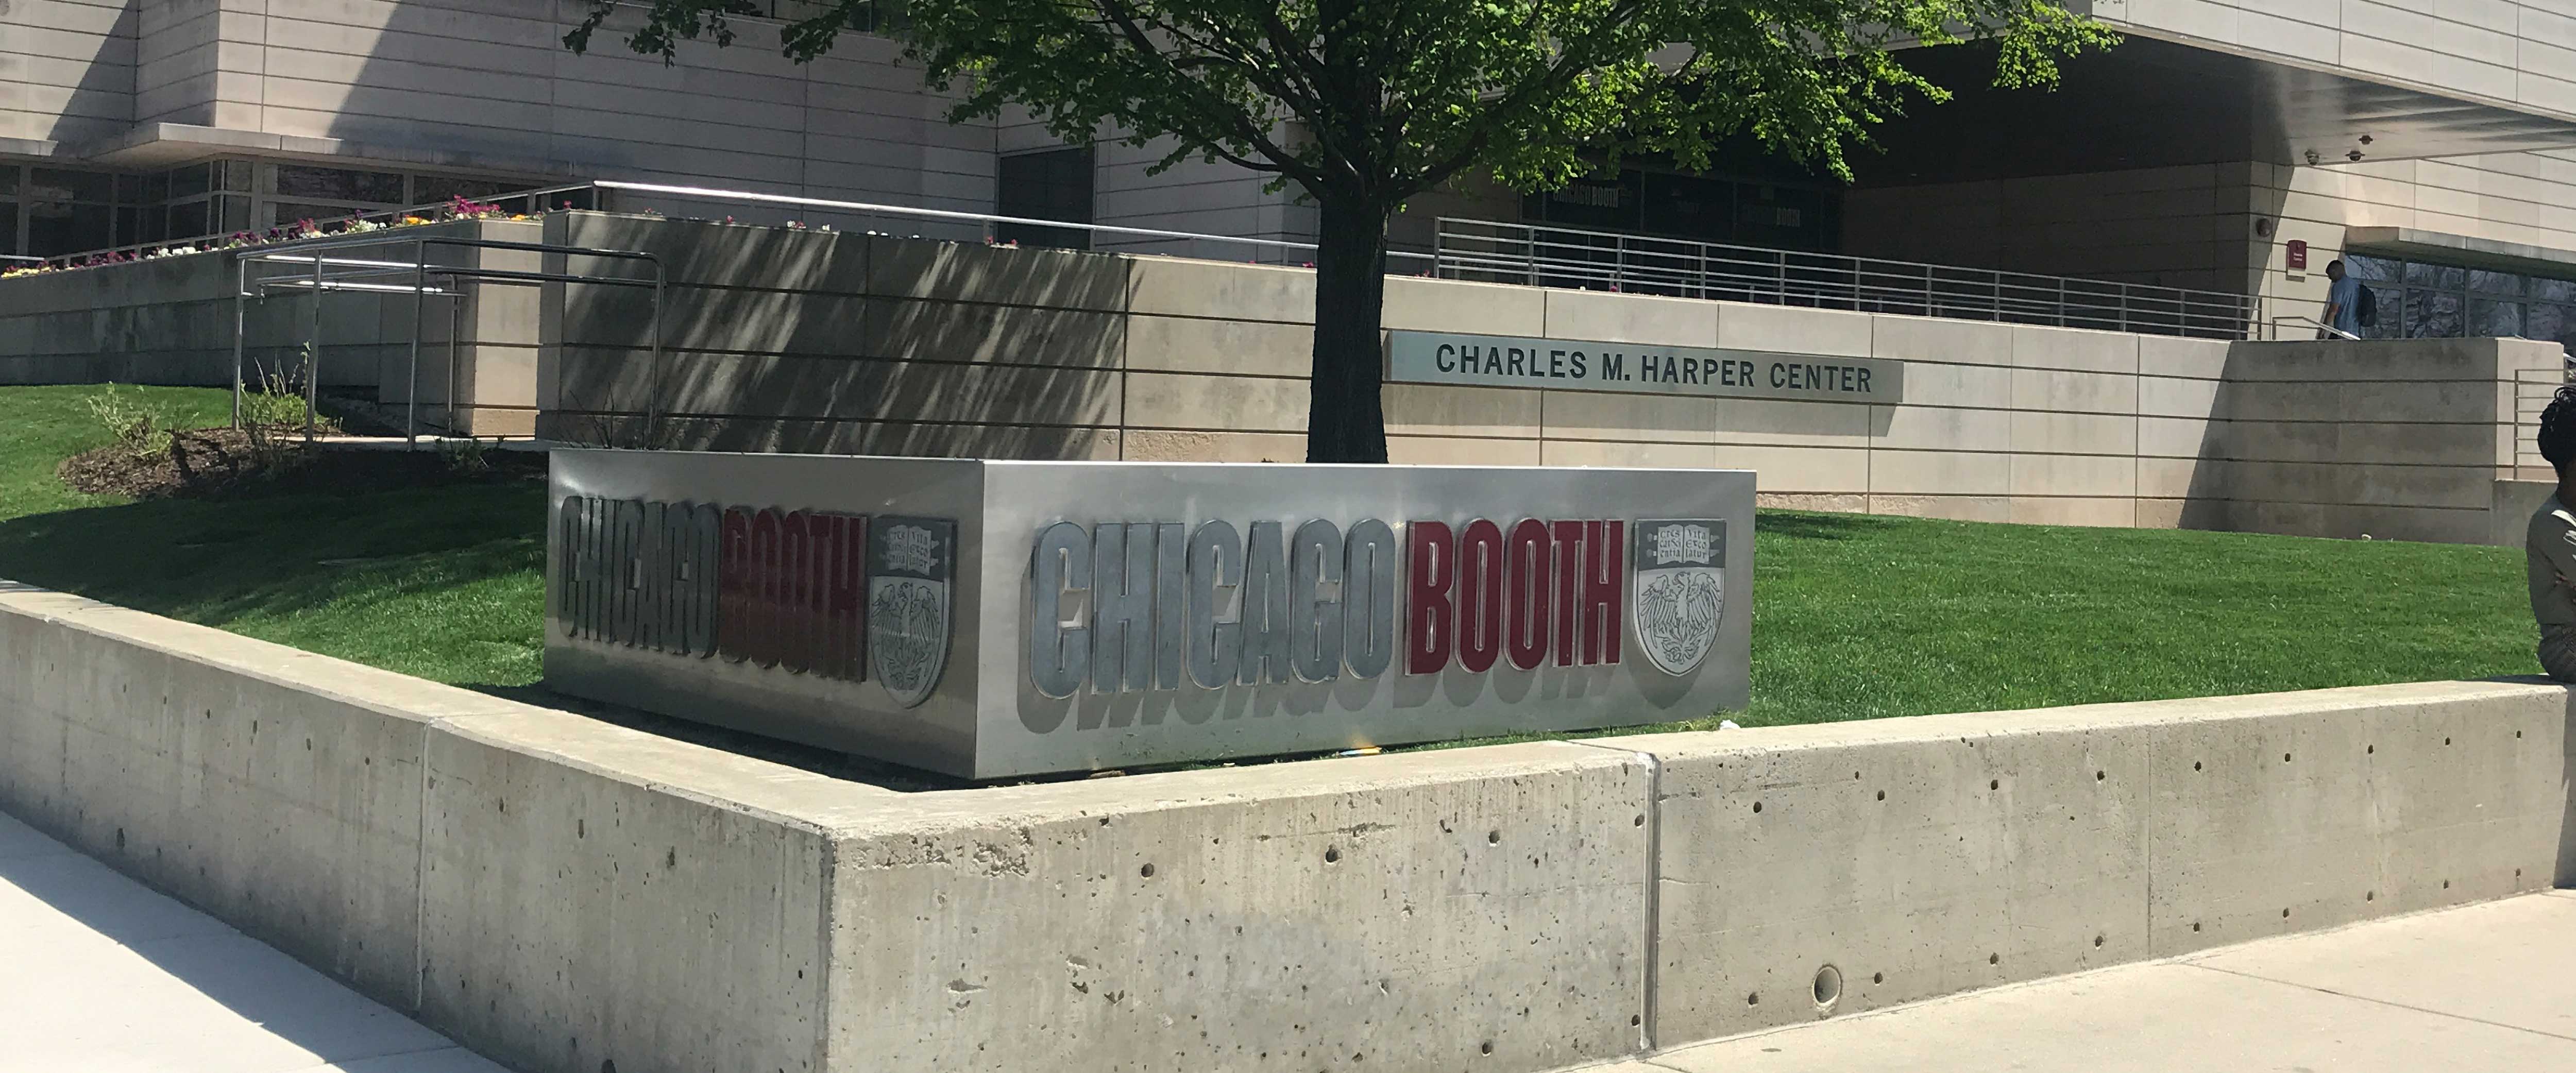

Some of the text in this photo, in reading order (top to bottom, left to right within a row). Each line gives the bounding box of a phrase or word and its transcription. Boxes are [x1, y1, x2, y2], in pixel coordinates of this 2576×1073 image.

[1591, 186, 1619, 208] BOOTH
[1436, 344, 1871, 393] CHARLES M. HARPER CENTER
[558, 496, 868, 684] CHICAGO BOOTH
[1030, 518, 1623, 700] CHICAGO BOOTH
